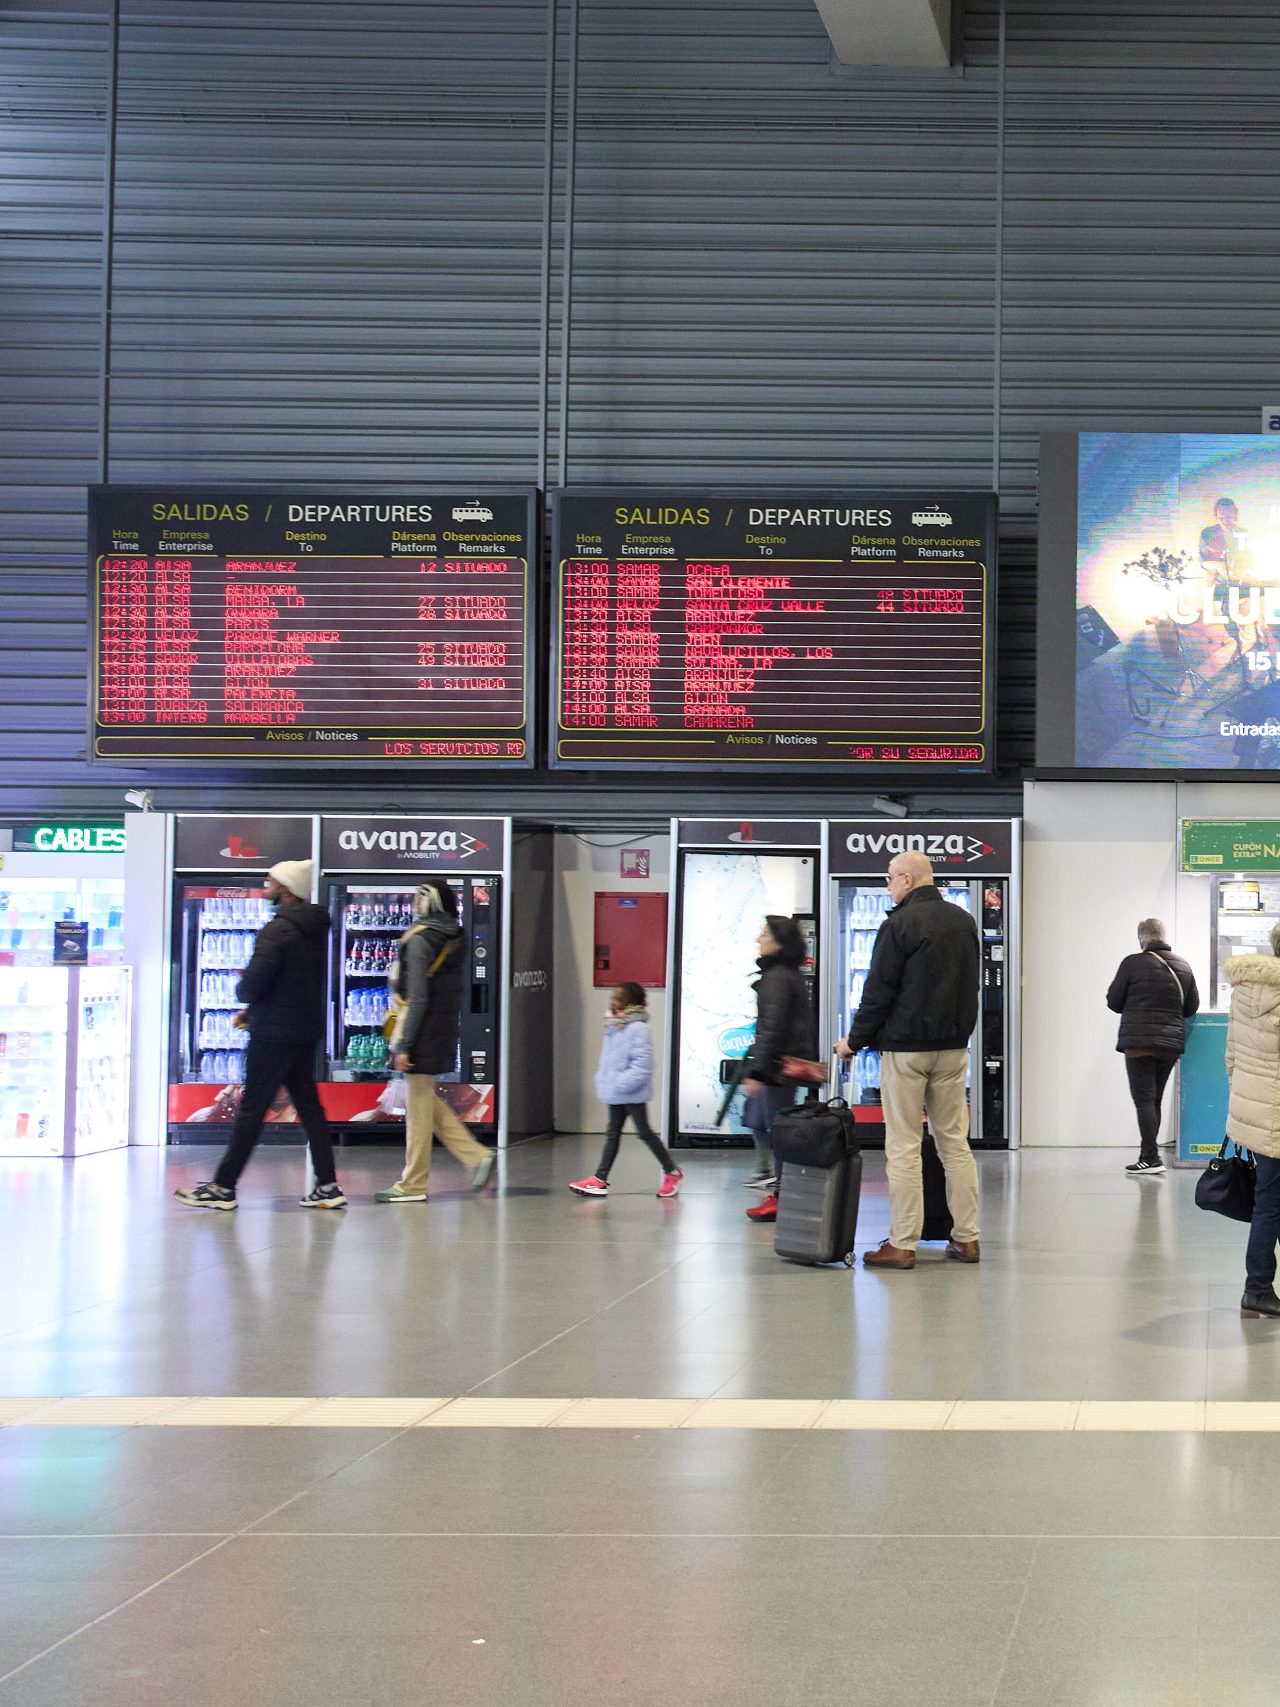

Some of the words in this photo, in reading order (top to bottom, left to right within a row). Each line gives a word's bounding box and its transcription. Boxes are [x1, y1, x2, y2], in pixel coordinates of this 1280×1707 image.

[152, 503, 249, 521] SALIDAS
[288, 504, 432, 523] DEPARTURES
[615, 508, 710, 526] SALIDAS
[748, 509, 891, 527] DEPARTURES
[112, 530, 138, 540] Hora
[163, 530, 209, 541] Empresa
[286, 531, 326, 541] Destino
[392, 531, 436, 542] Dársena
[442, 532, 521, 543] Observaciones
[576, 534, 601, 543] Hora
[625, 534, 671, 545] Empresa
[746, 534, 786, 544] Destino
[852, 535, 895, 546] Dársena
[113, 541, 139, 551] Time
[158, 541, 213, 553] Enterprise
[299, 543, 313, 552] To
[391, 542, 436, 553] Platform
[902, 536, 981, 548] Observaciones
[459, 543, 505, 554] Remarks
[576, 545, 602, 555] Time
[622, 545, 674, 557] Enterprise
[759, 546, 772, 555] To
[851, 546, 896, 557] Platform
[918, 548, 964, 558] Remarks
[1246, 652, 1271, 670] 15
[225, 678, 269, 687] GIJON
[444, 678, 506, 688] SITUADO
[155, 701, 207, 710] AVANZA
[225, 702, 304, 711] SALAMANCA
[565, 715, 606, 726] 14:00
[615, 716, 657, 726] SAMAR
[685, 717, 754, 727] CAMARENA
[266, 730, 303, 741] Avisos
[315, 730, 358, 741] Notices
[726, 734, 763, 744] Avisos
[775, 734, 817, 745] Notices
[385, 744, 412, 754] LOS
[420, 744, 499, 754] SERVICIOS
[35, 828, 128, 851] CABLES
[339, 830, 457, 851] avanza
[846, 833, 964, 854] avanza
[1233, 842, 1261, 850] CUPÓN
